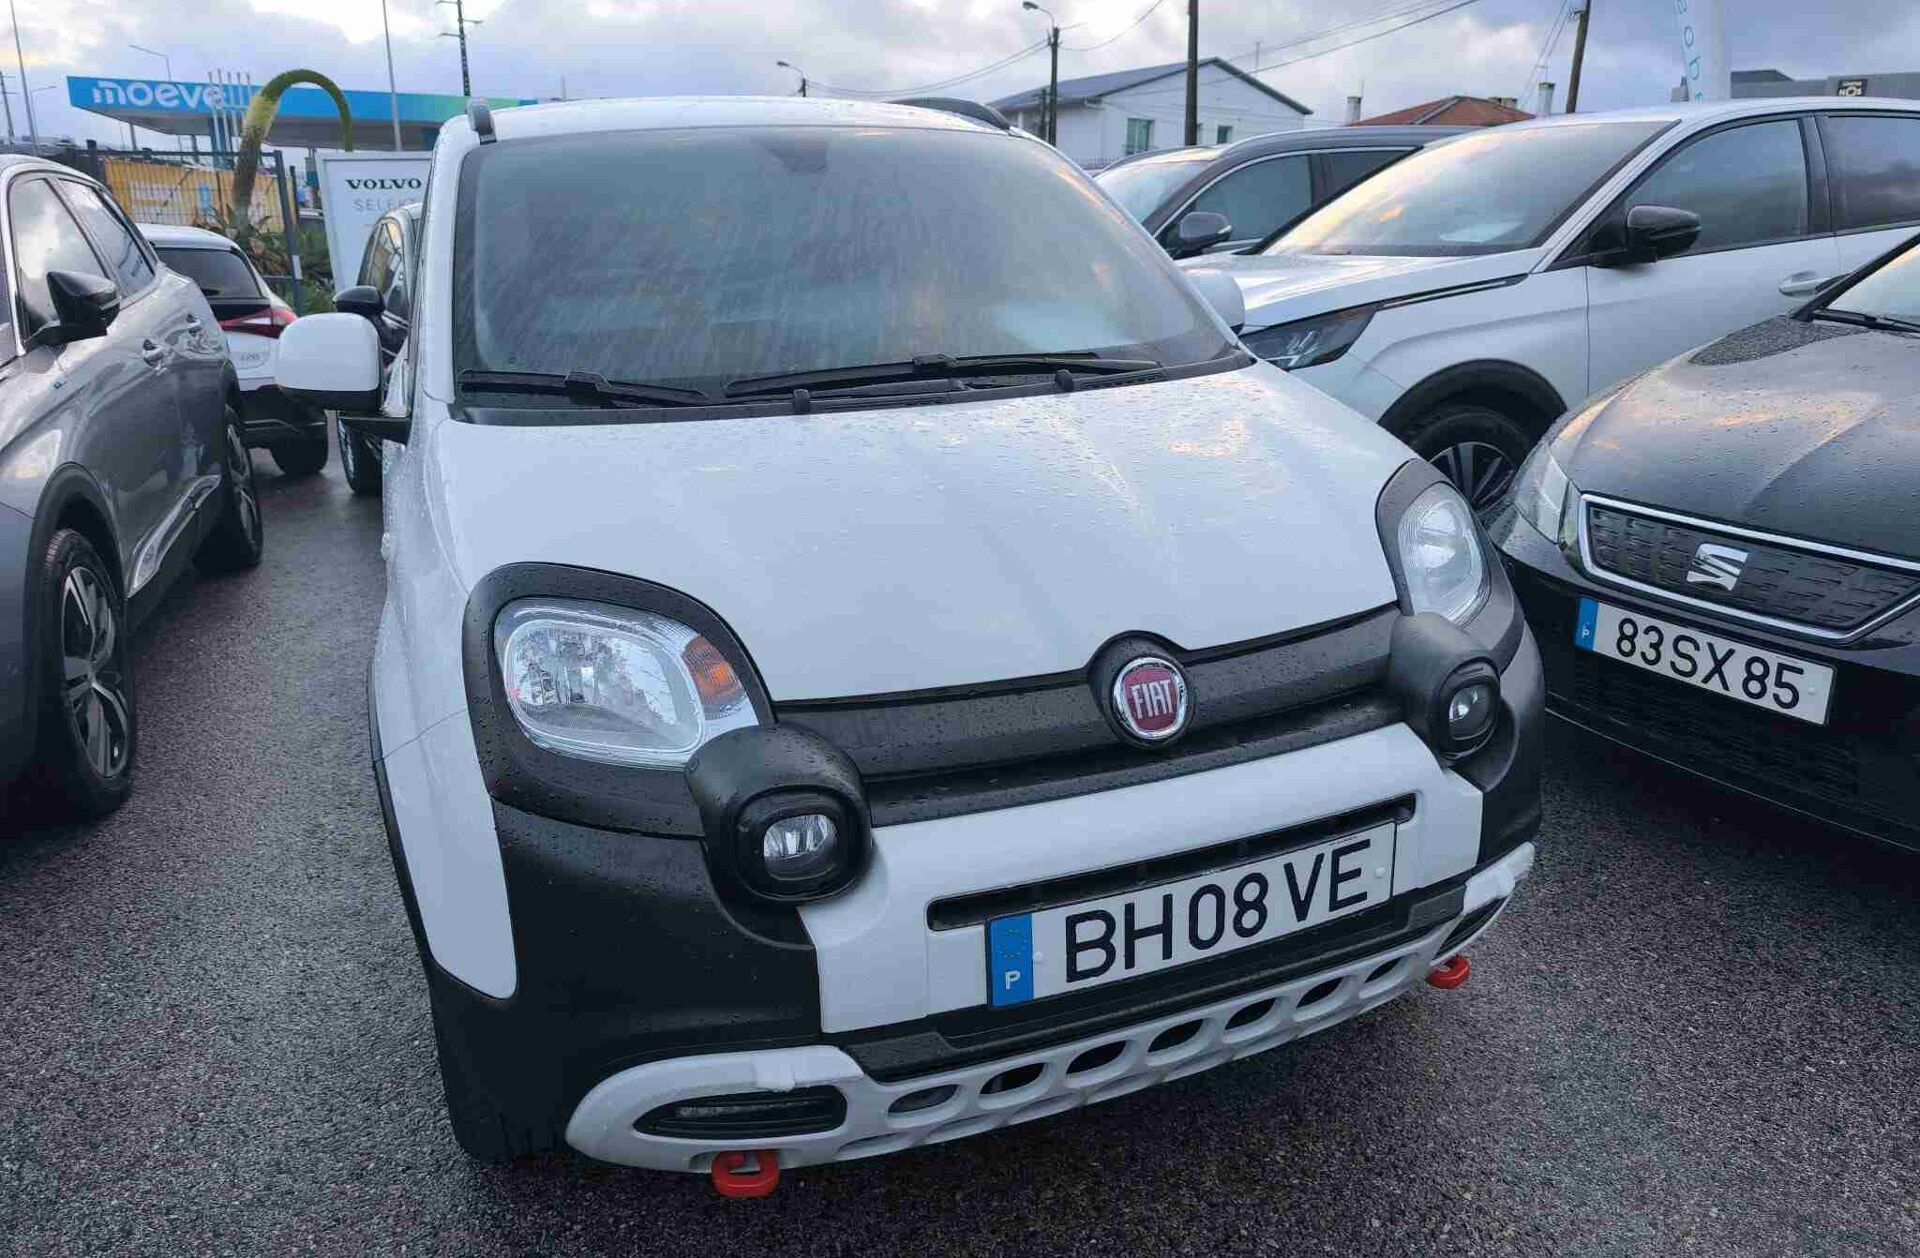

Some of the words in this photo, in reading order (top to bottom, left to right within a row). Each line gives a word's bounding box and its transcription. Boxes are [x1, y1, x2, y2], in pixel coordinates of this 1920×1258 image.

[92, 80, 224, 109] moeve
[345, 178, 422, 190] VOLVO
[1130, 679, 1174, 720] FIAT
[1005, 970, 1021, 990] P
